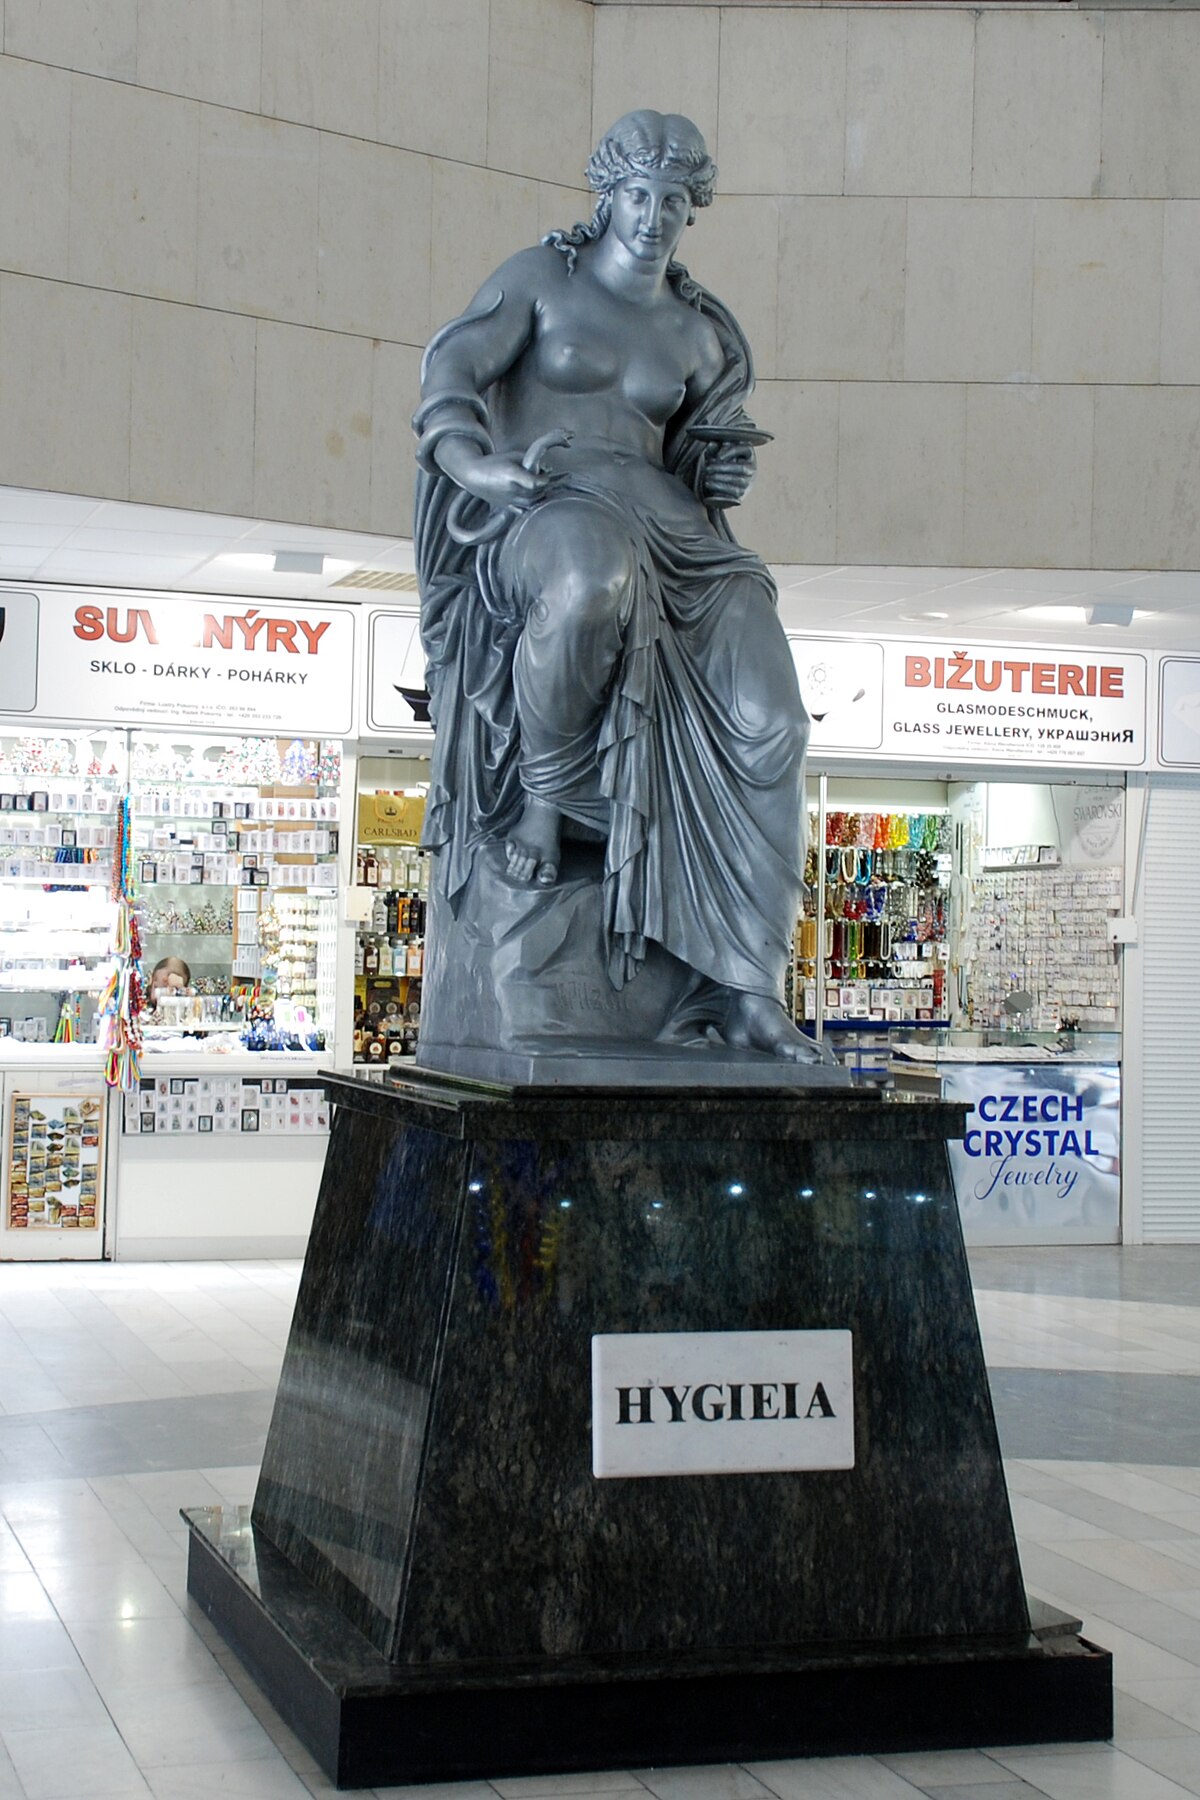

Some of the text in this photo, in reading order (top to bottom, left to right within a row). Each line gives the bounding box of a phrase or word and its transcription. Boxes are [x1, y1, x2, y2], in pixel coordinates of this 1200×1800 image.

[73, 605, 332, 655] SUVNÝRY
[90, 660, 136, 675] SKLO
[153, 662, 211, 680] DÁRKY
[228, 668, 309, 685] POHÁRKY
[905, 651, 1124, 698] BIŽUTERIE
[936, 702, 1094, 722] GLASMODESCHMUCK,
[893, 721, 941, 735] GLASS
[945, 723, 1034, 741] JEWELLERY,
[363, 826, 417, 837] CARLSBAD
[978, 1095, 1083, 1123] CZECH
[963, 1129, 1099, 1157] CRYSTAL
[974, 1154, 1079, 1201] Jewelry
[615, 1381, 837, 1425] HYGIEIA
